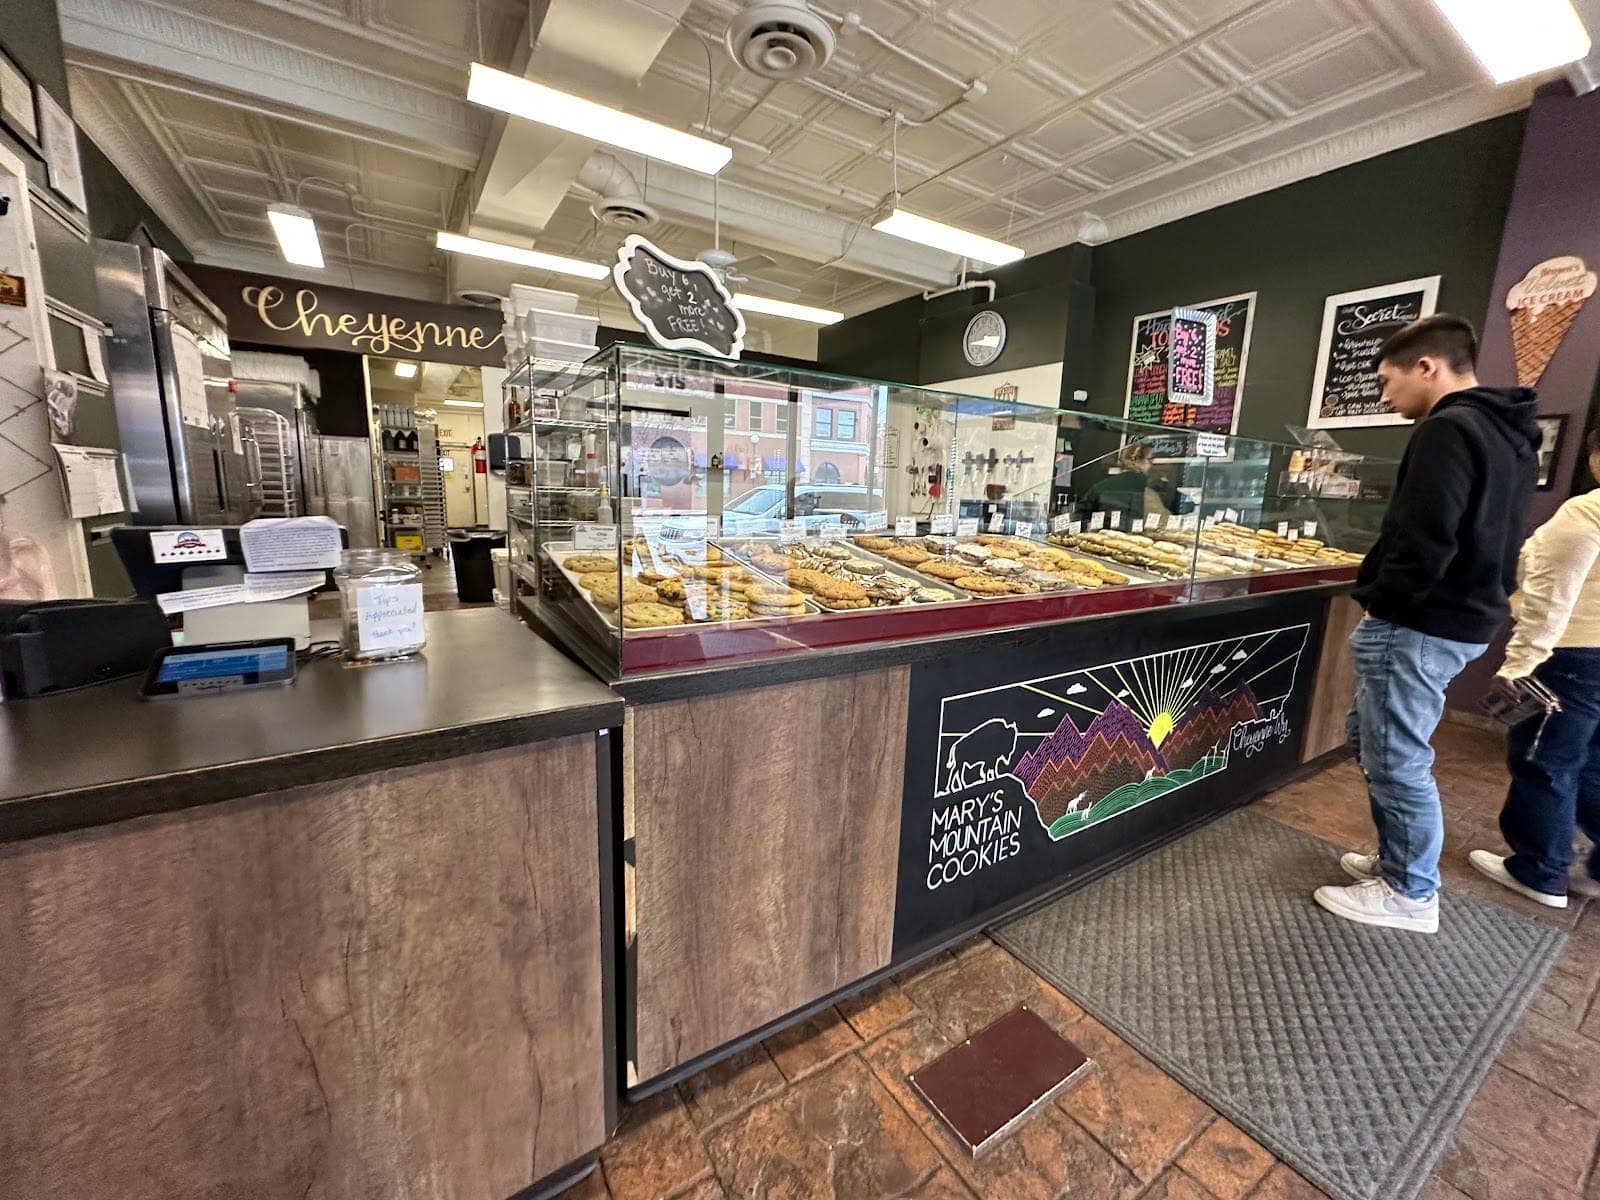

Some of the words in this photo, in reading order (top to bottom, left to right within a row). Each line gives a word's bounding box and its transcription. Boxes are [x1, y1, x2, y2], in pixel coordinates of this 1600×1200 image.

[644, 258, 677, 286] Buy
[661, 284, 682, 302] get
[686, 291, 698, 305] 2
[1518, 295, 1537, 306] ICE
[1539, 289, 1584, 304] CREAM
[242, 285, 502, 354] Cheyenne
[679, 304, 706, 317] more
[1350, 302, 1412, 330] Secret
[667, 315, 708, 336] FREE!
[1190, 346, 1199, 358] 2
[1175, 366, 1203, 393] FREE!
[364, 601, 417, 623] Appreciated
[374, 594, 399, 607] Tips
[1233, 725, 1273, 759] Cheyenne
[931, 789, 1004, 836] MARY'S
[929, 805, 1022, 864] MOUNTAIN
[927, 832, 1021, 890] COOKIES
